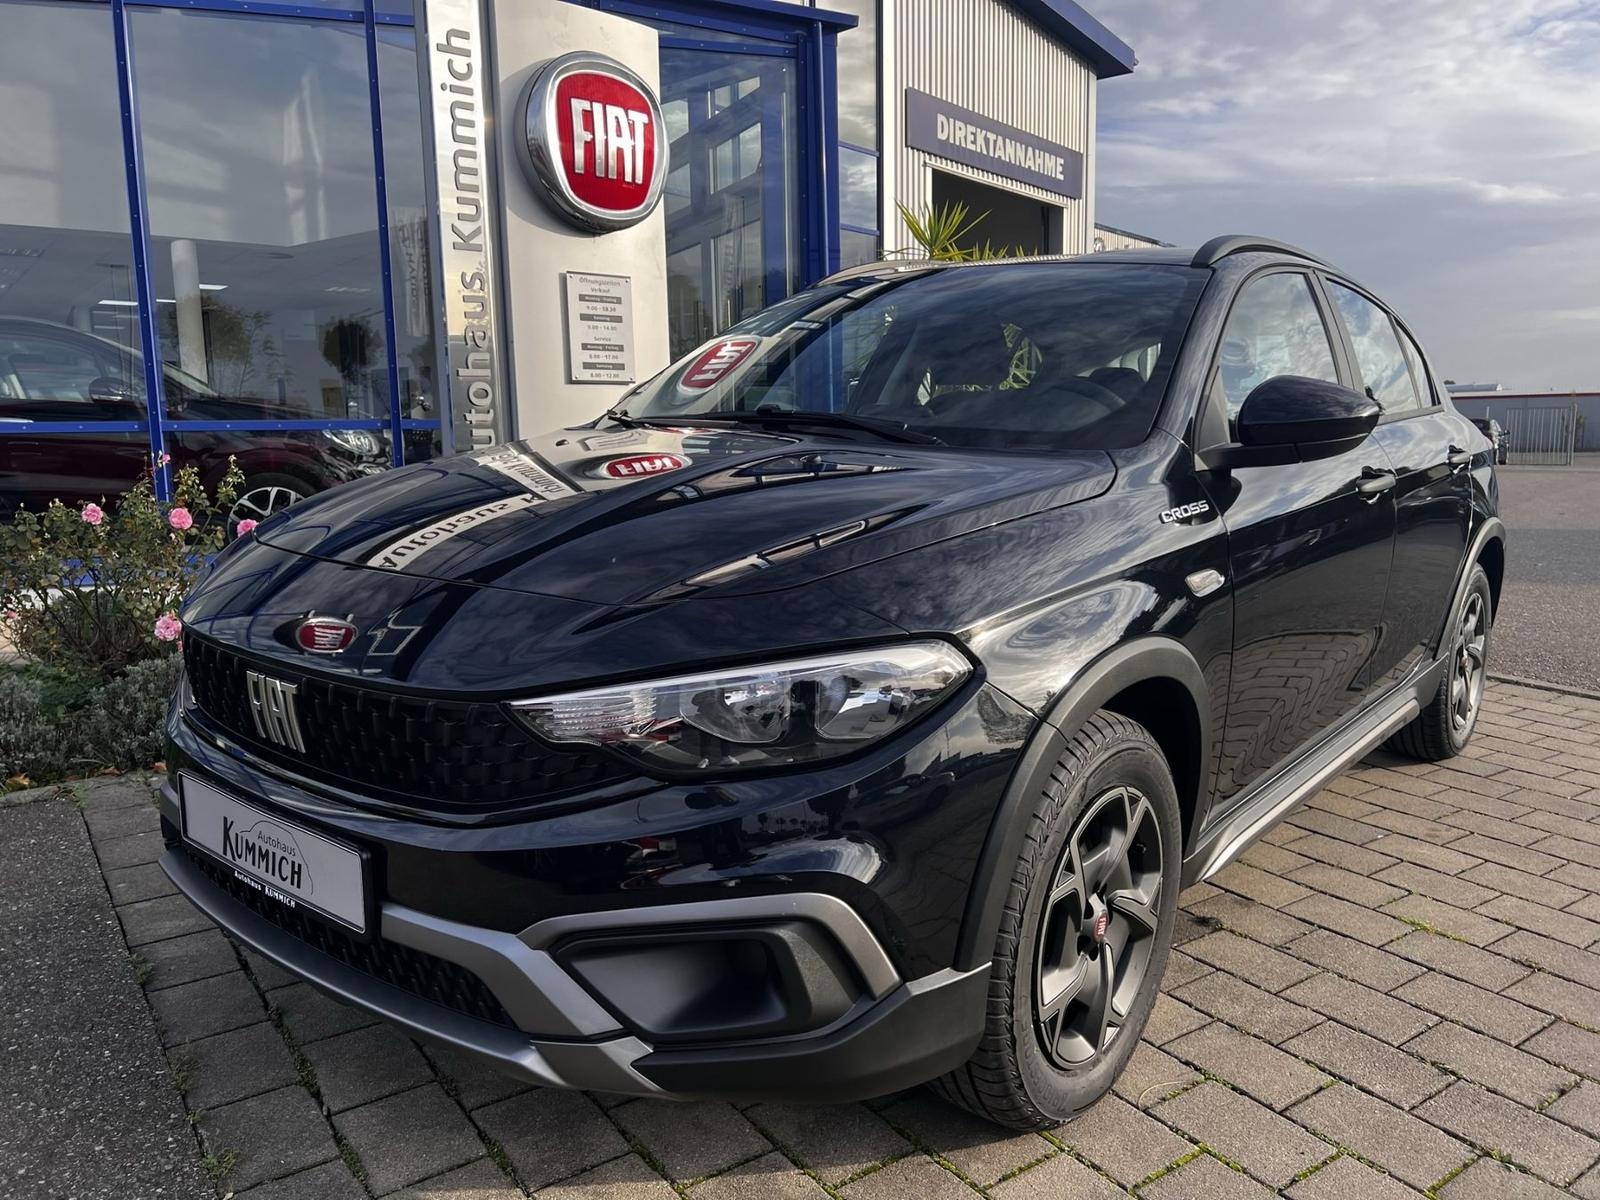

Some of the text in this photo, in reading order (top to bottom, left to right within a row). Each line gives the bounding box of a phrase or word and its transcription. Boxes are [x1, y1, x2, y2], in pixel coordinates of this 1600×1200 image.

[570, 97, 648, 184] FIAT
[937, 113, 1065, 181] DIREKTANNAHME
[436, 28, 496, 450] utohaus Kummich
[1161, 499, 1210, 523] CROSS
[246, 670, 306, 754] FIAT
[257, 830, 297, 857] Autohaus
[234, 869, 262, 891] Autohaus
